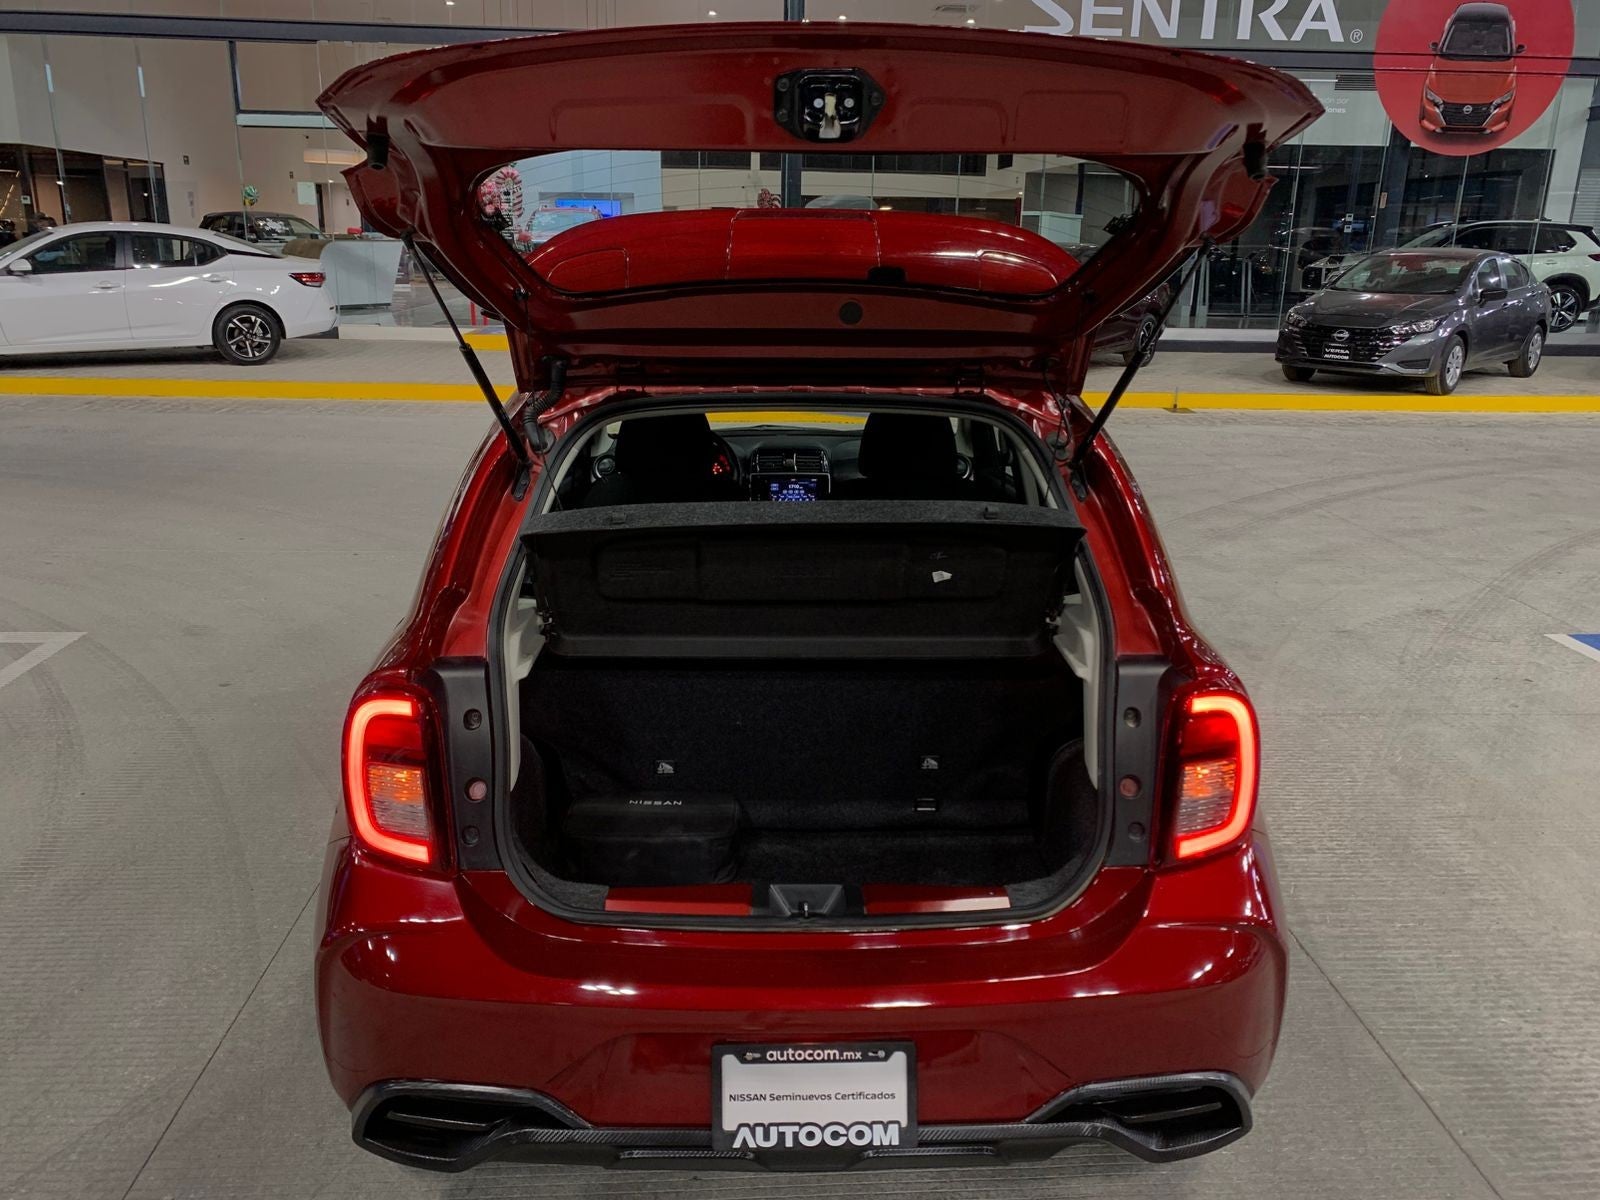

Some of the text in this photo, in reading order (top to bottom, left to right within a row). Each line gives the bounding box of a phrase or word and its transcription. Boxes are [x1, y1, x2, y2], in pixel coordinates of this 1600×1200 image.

[766, 1047, 863, 1061] autocom.mx
[729, 1091, 896, 1102] NISSAN Seminuevos Certificados
[732, 1123, 900, 1149] AUTOCOM
